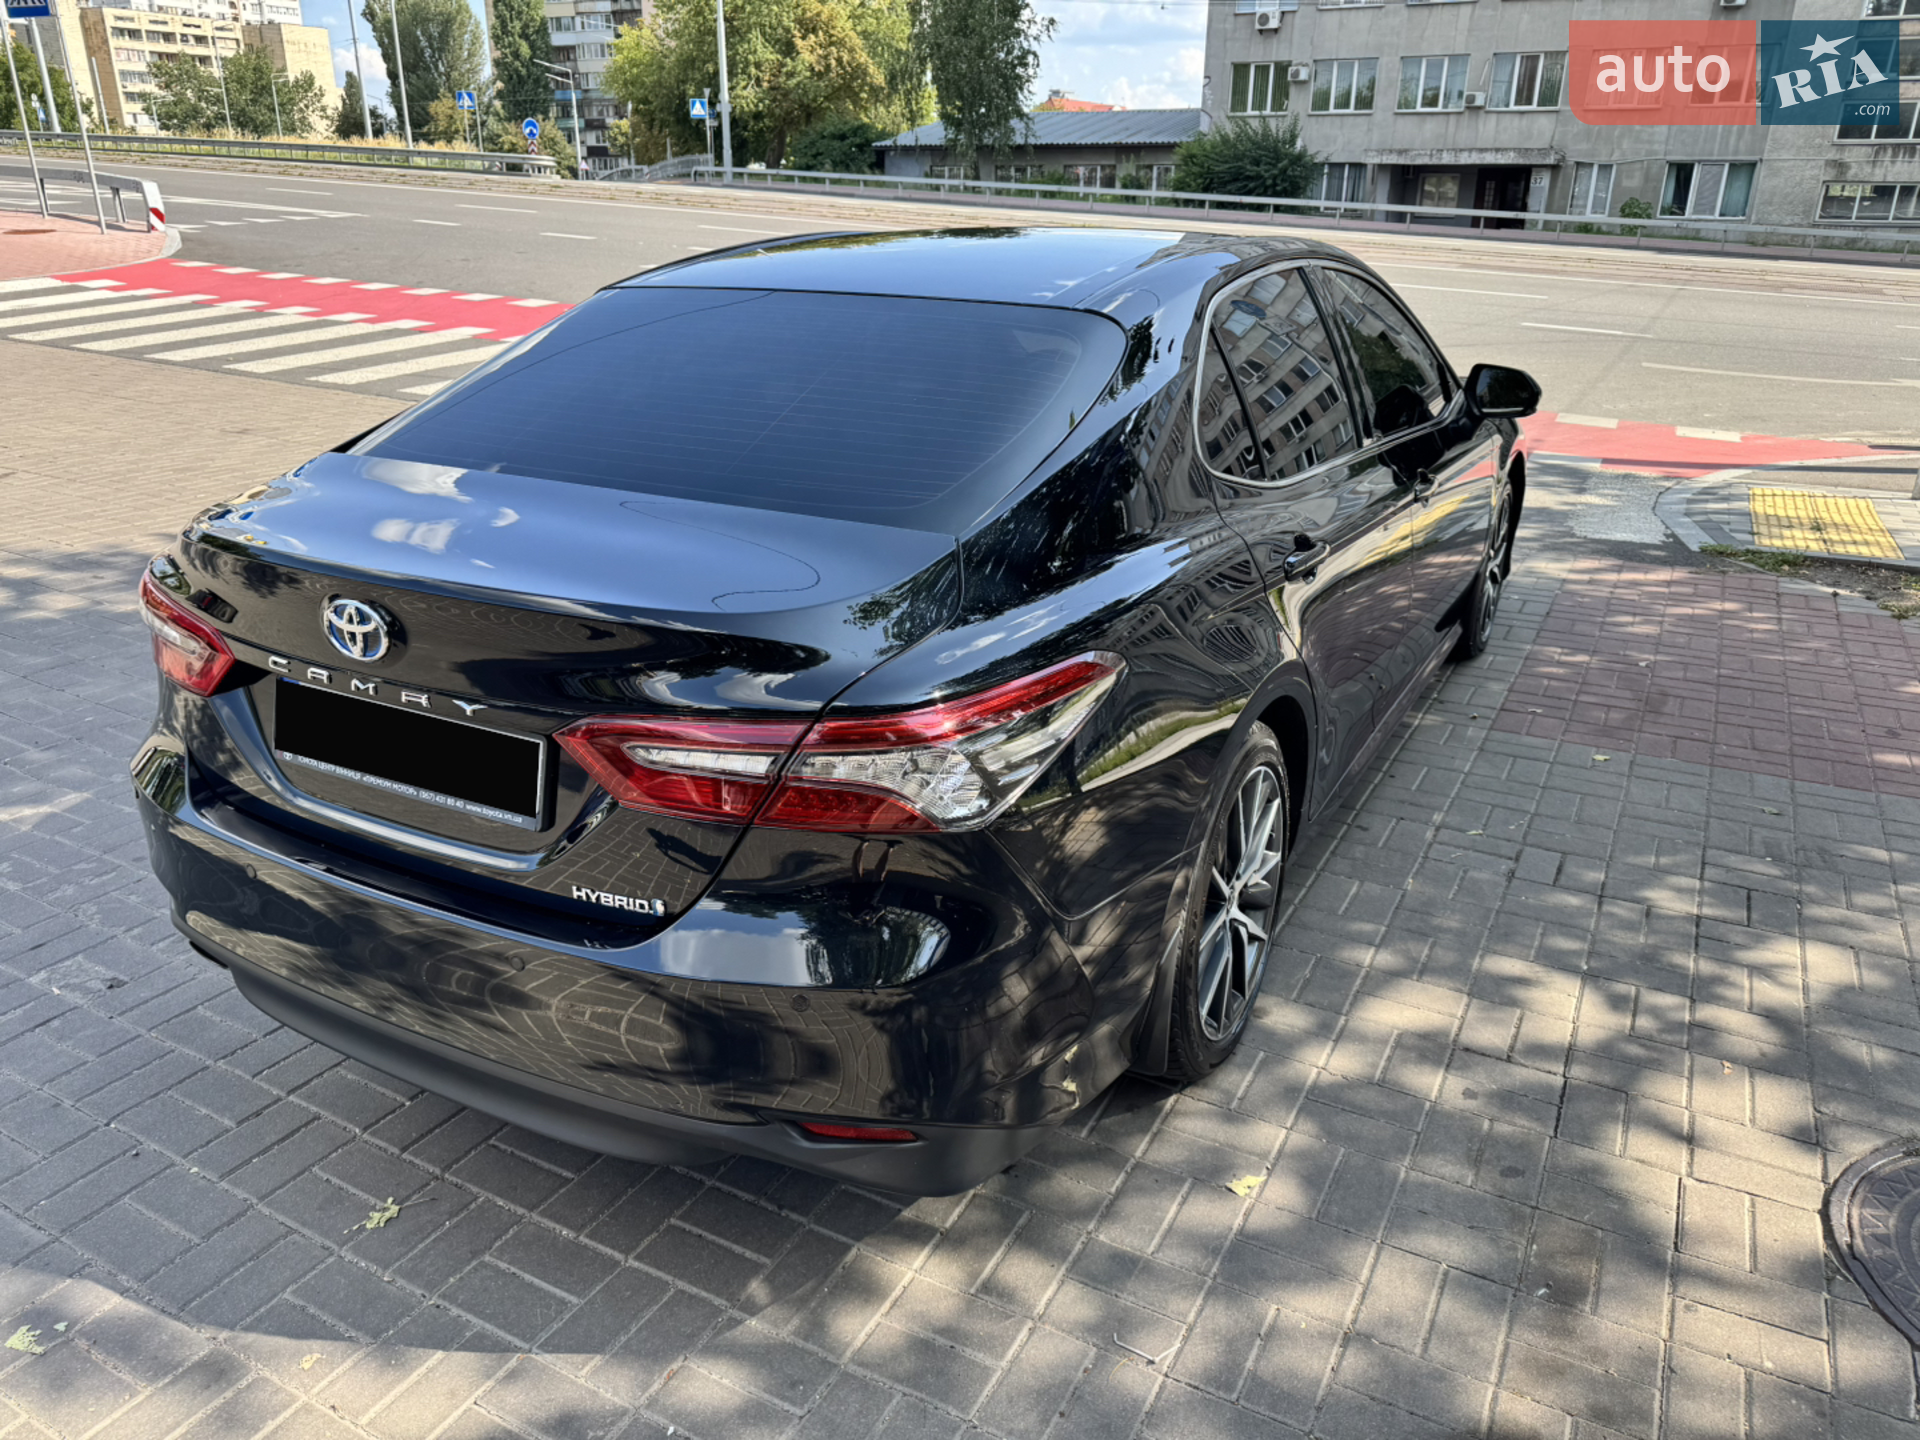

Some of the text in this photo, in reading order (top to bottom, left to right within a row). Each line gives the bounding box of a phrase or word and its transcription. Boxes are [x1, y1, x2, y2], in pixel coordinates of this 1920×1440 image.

[1531, 176, 1543, 185] 37
[268, 655, 488, 717] CAMRY
[571, 885, 649, 913] HYBRID
